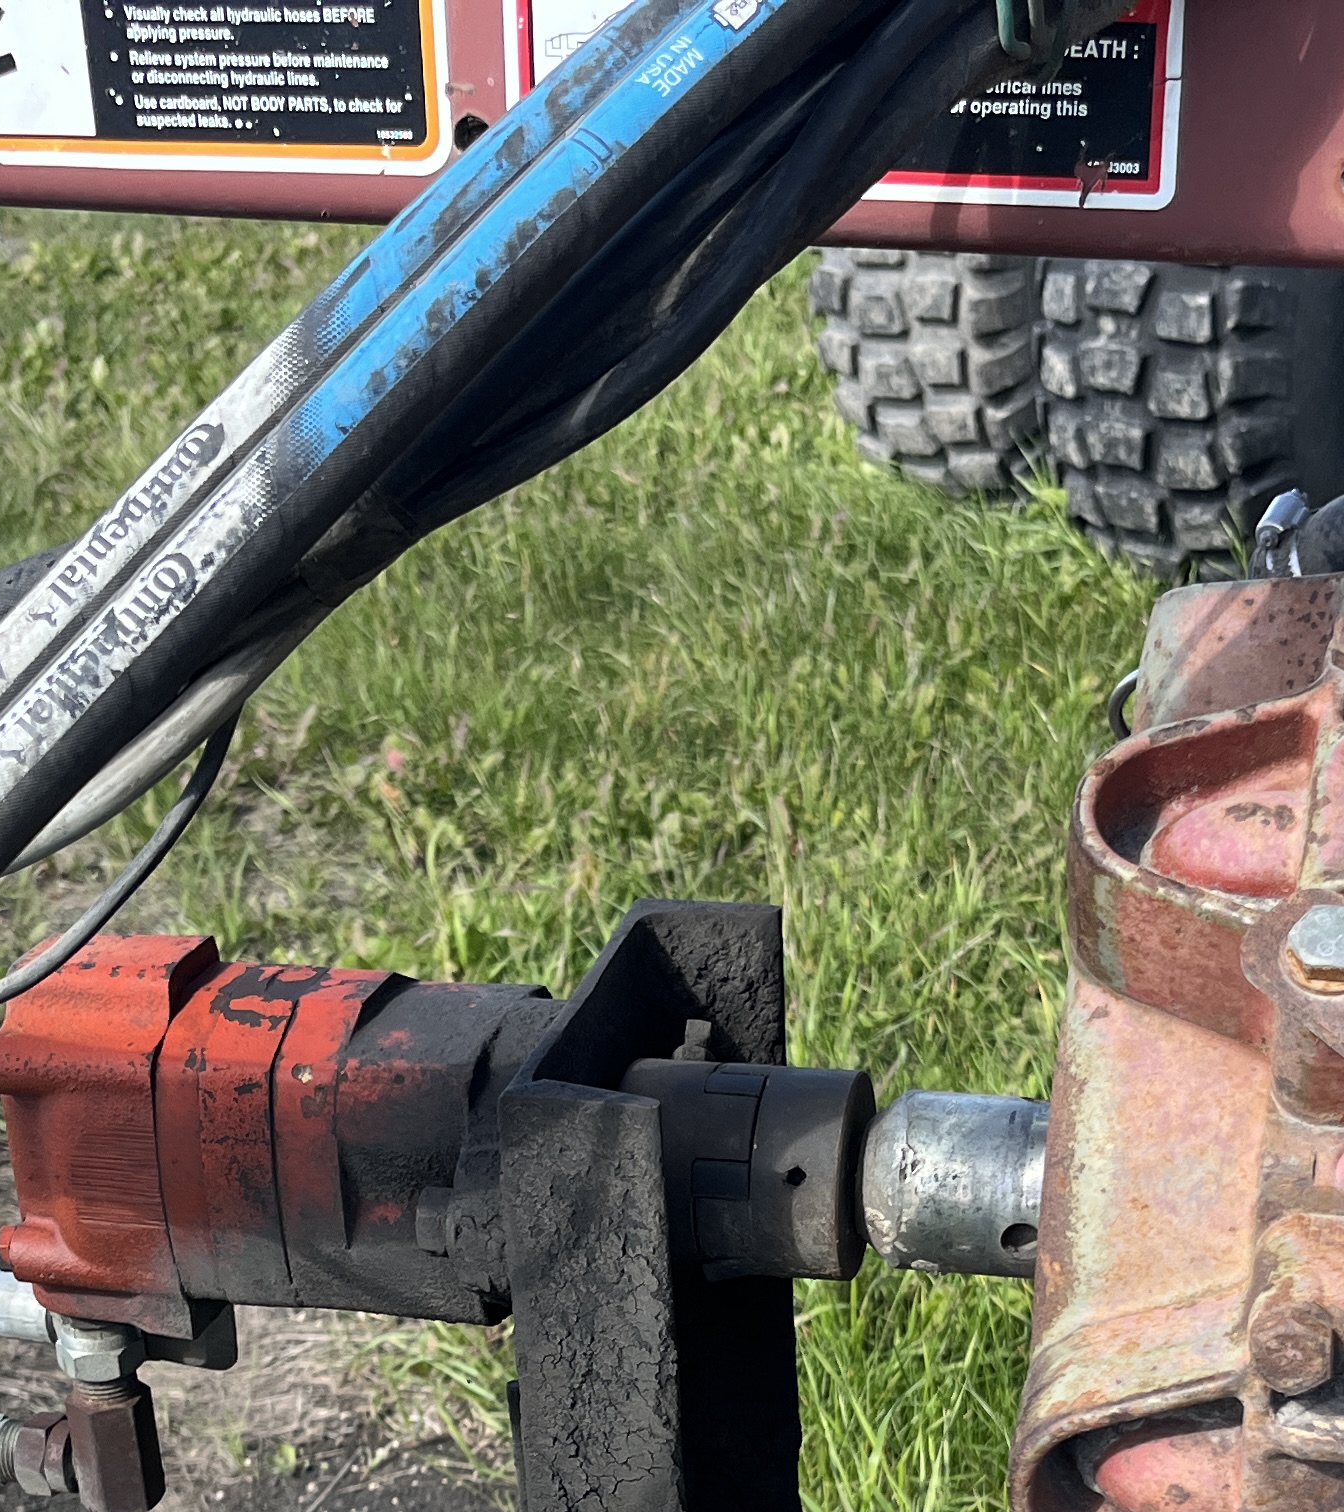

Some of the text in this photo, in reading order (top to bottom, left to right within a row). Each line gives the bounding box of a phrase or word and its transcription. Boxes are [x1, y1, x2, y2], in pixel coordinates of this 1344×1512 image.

[123, 5, 375, 25] Visually check all hydraulic hoses BEFORE
[126, 23, 235, 43] applying pressure.
[668, 34, 693, 54] IN
[129, 50, 389, 70] Relieve system pressure before maintenance
[633, 52, 674, 85] USA
[131, 70, 320, 88] or disconnecting hydraulic lines.
[650, 46, 705, 97] MADE
[133, 94, 403, 115] Use cardboard, NOT BODY PARTS, to check for
[970, 101, 1051, 120] operating
[1056, 101, 1088, 117] this
[136, 113, 233, 130] suspected leaks.
[47, 423, 225, 609] Continental
